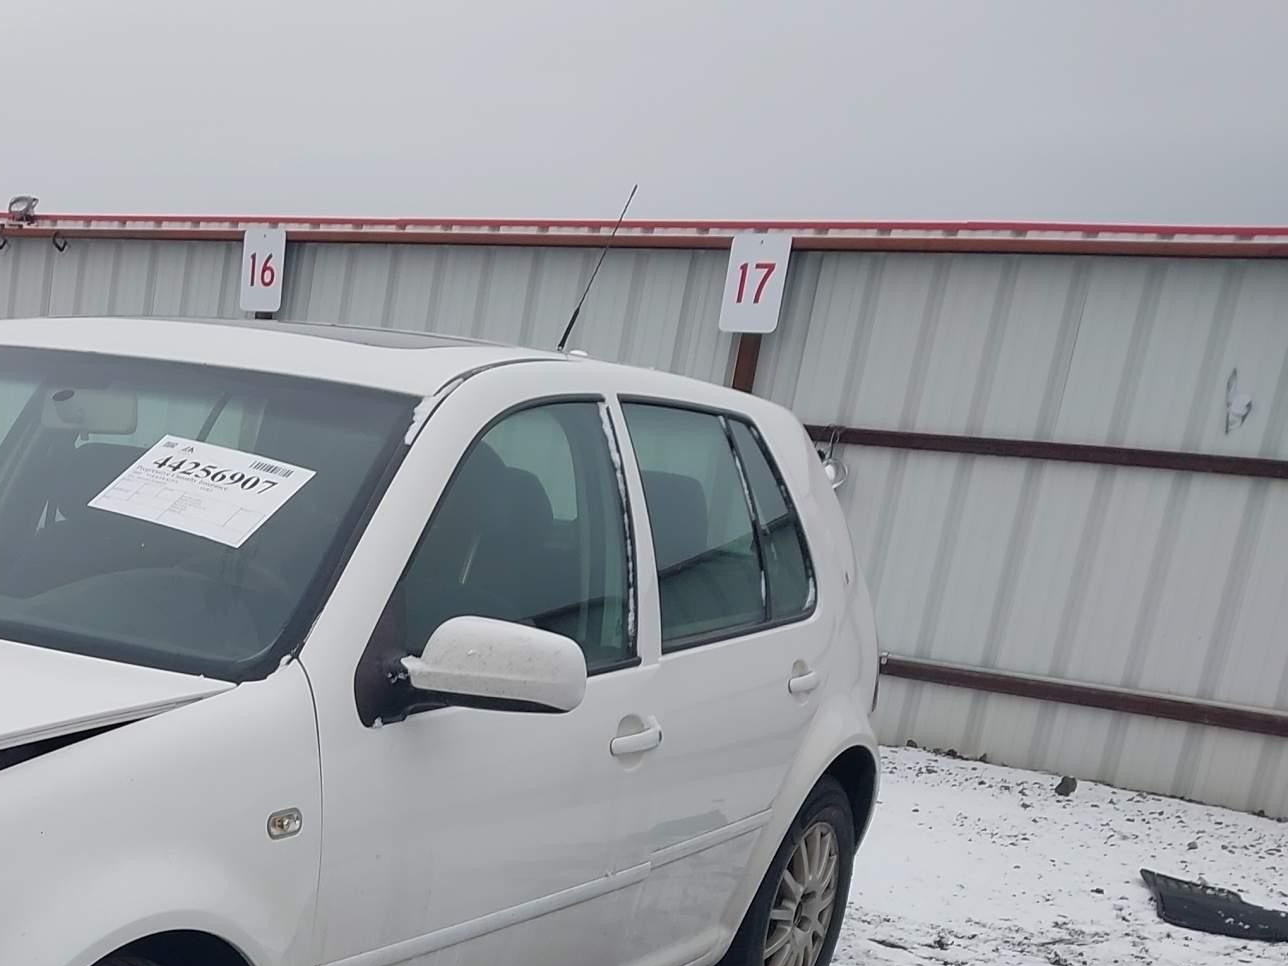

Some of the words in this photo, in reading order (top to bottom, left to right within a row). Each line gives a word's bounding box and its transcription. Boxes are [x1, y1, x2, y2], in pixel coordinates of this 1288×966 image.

[250, 252, 275, 287] 16
[735, 262, 777, 304] 17
[153, 456, 278, 494] 44256907
